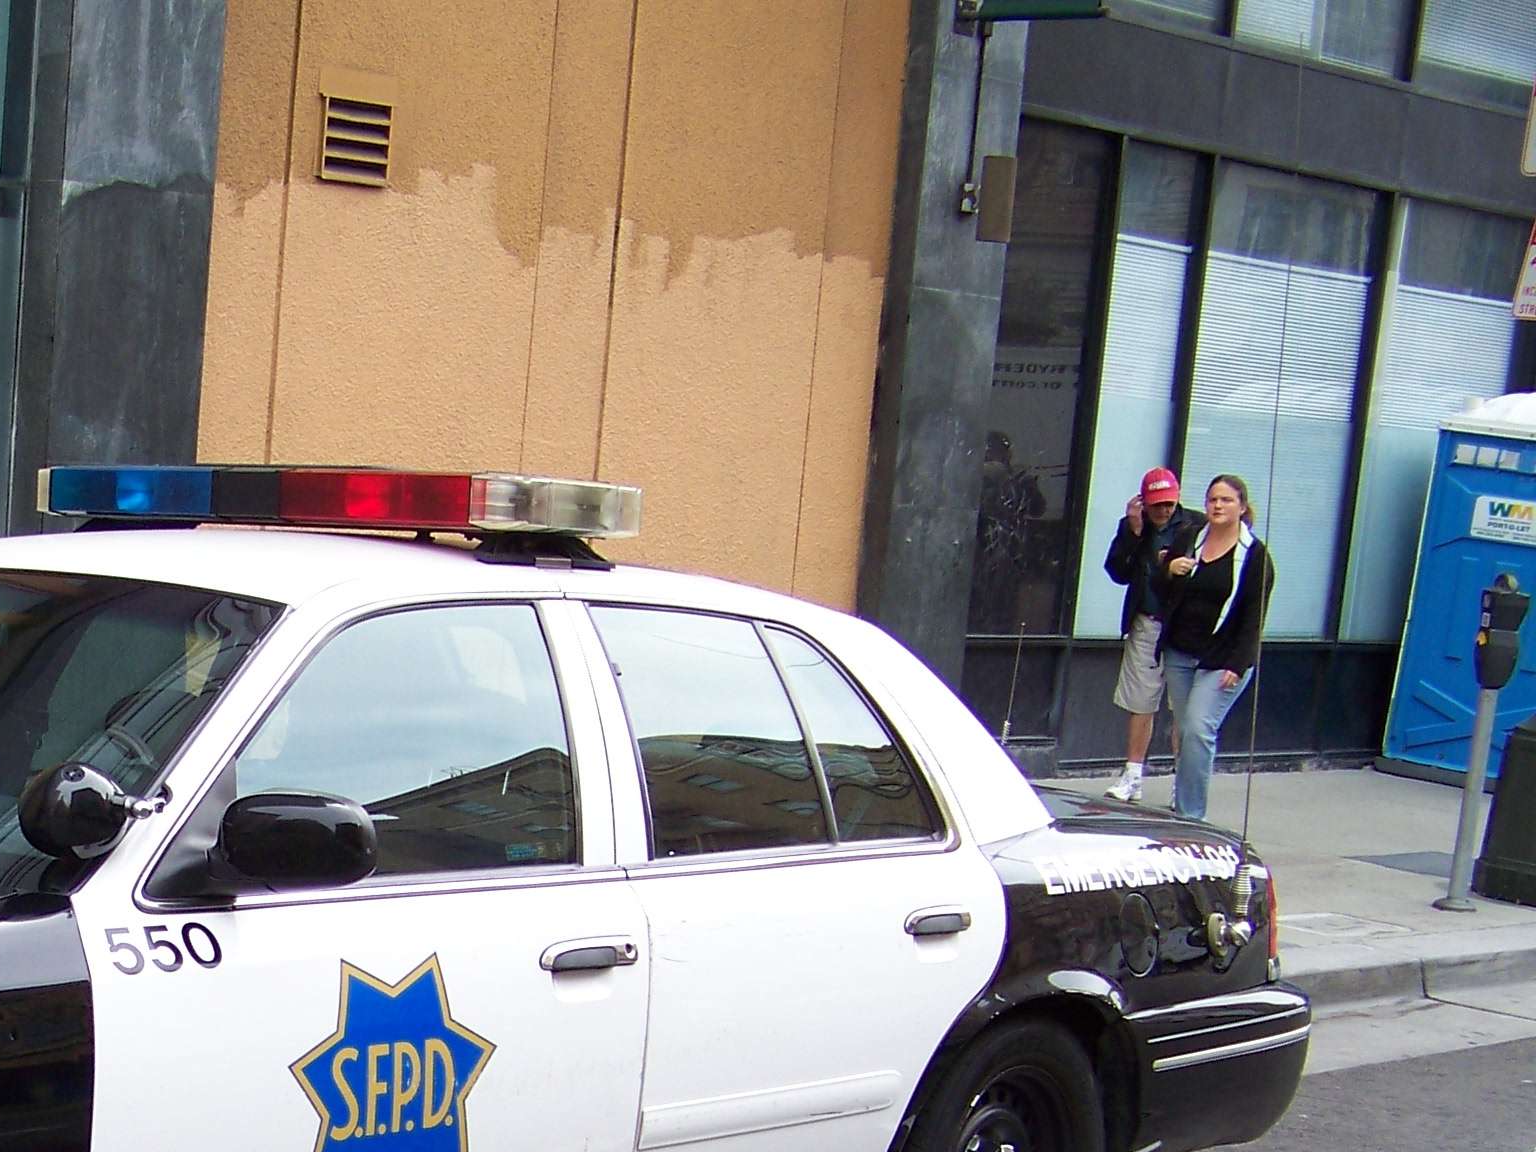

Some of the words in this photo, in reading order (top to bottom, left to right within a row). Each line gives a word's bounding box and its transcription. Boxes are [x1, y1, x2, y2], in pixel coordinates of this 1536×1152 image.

[1489, 501, 1533, 520] WM
[104, 921, 223, 976] 550
[329, 1038, 456, 1141] S.F.P.D.
